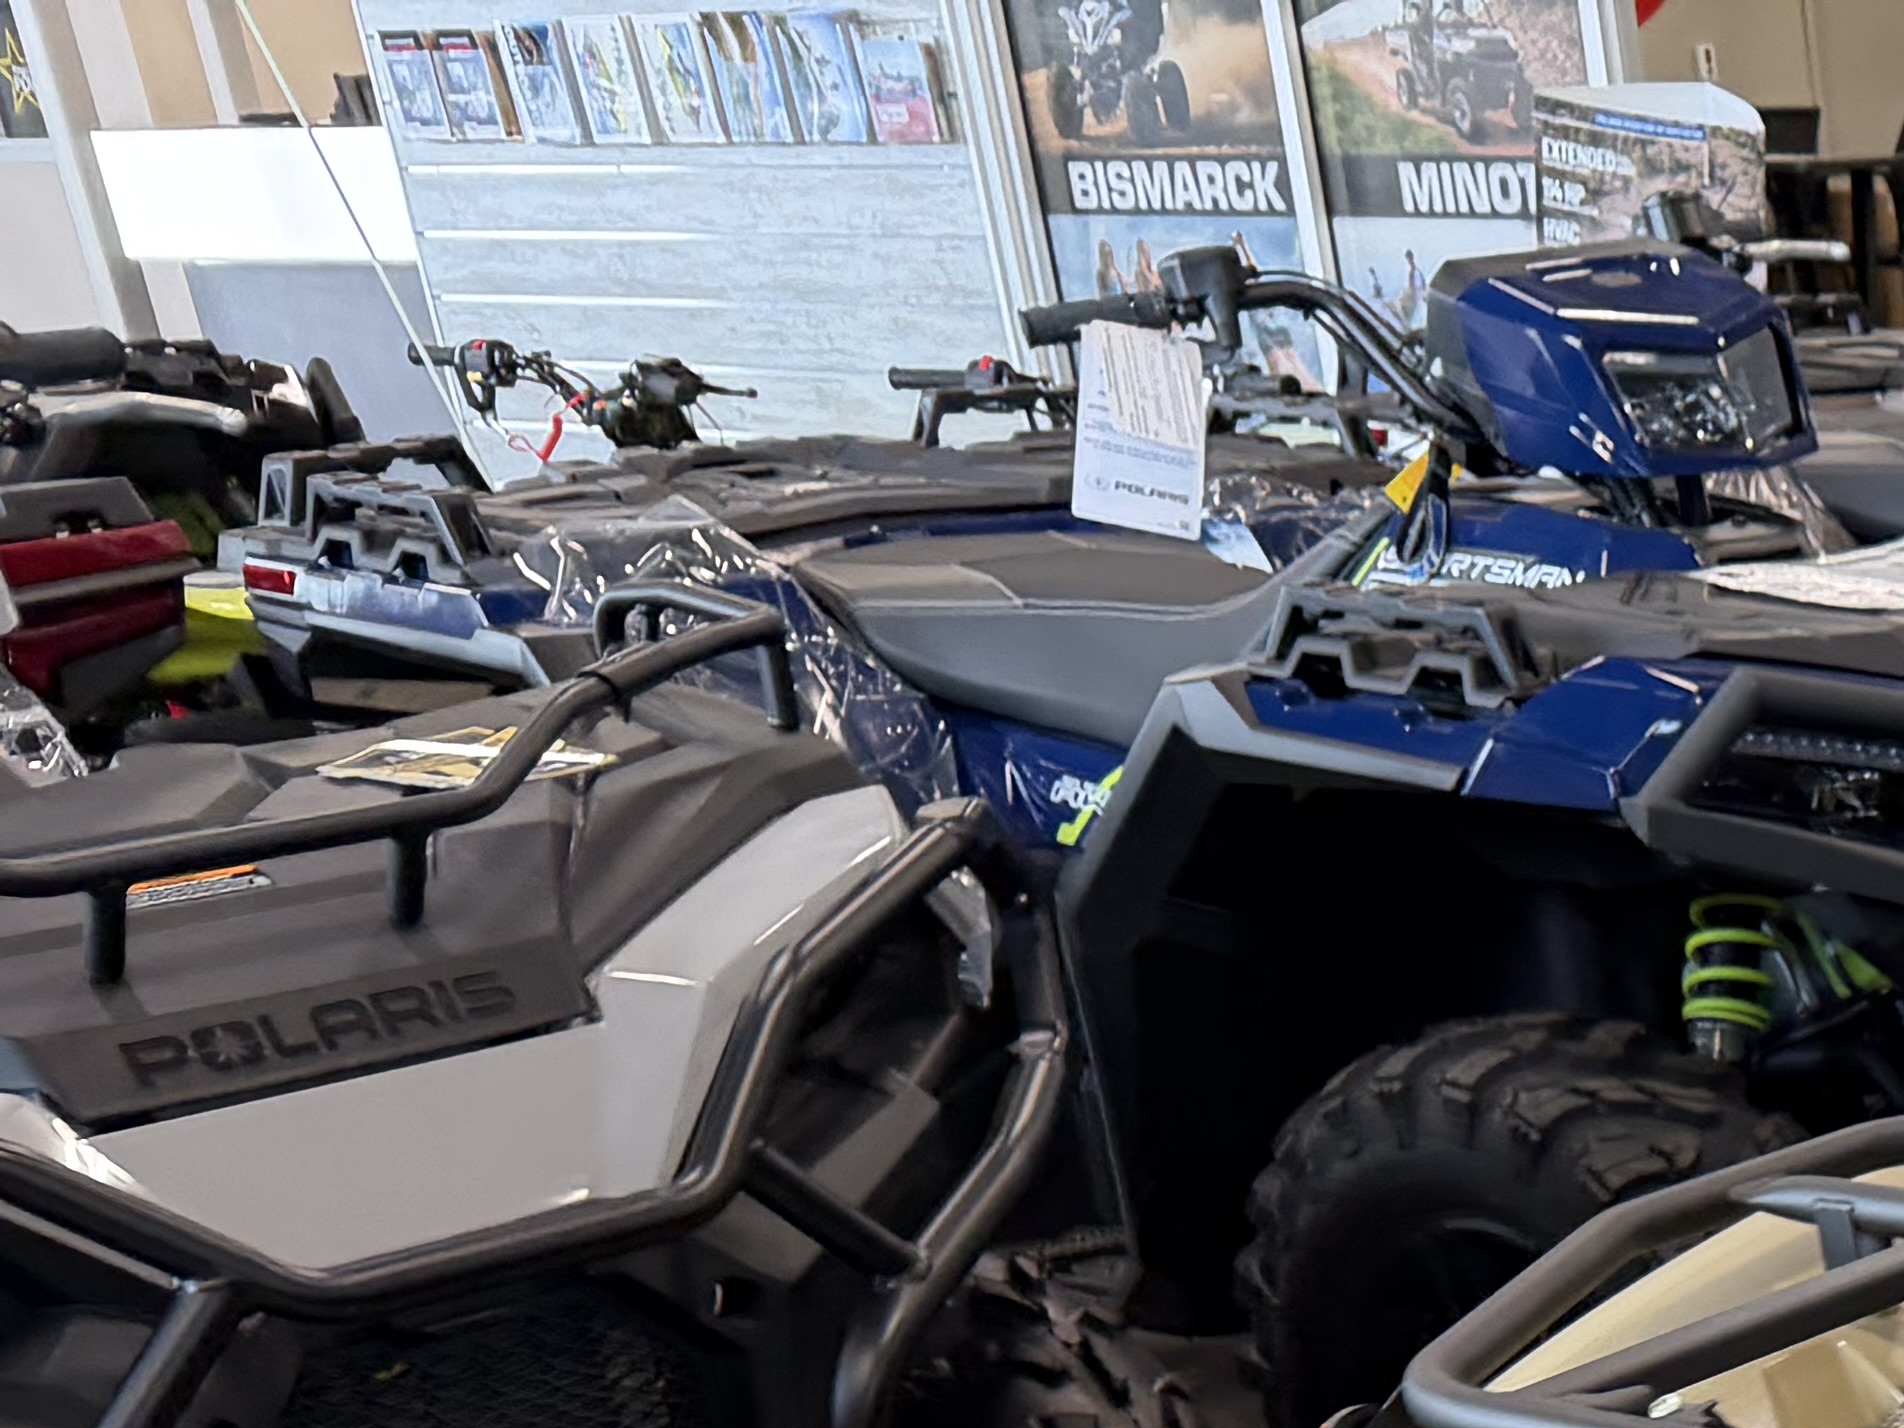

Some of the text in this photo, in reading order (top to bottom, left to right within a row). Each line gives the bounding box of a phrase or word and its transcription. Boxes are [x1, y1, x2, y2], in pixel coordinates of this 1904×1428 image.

[1067, 160, 1287, 212] BISMARCK
[1397, 161, 1537, 215] MINOT
[118, 969, 516, 1088] POLARIS
